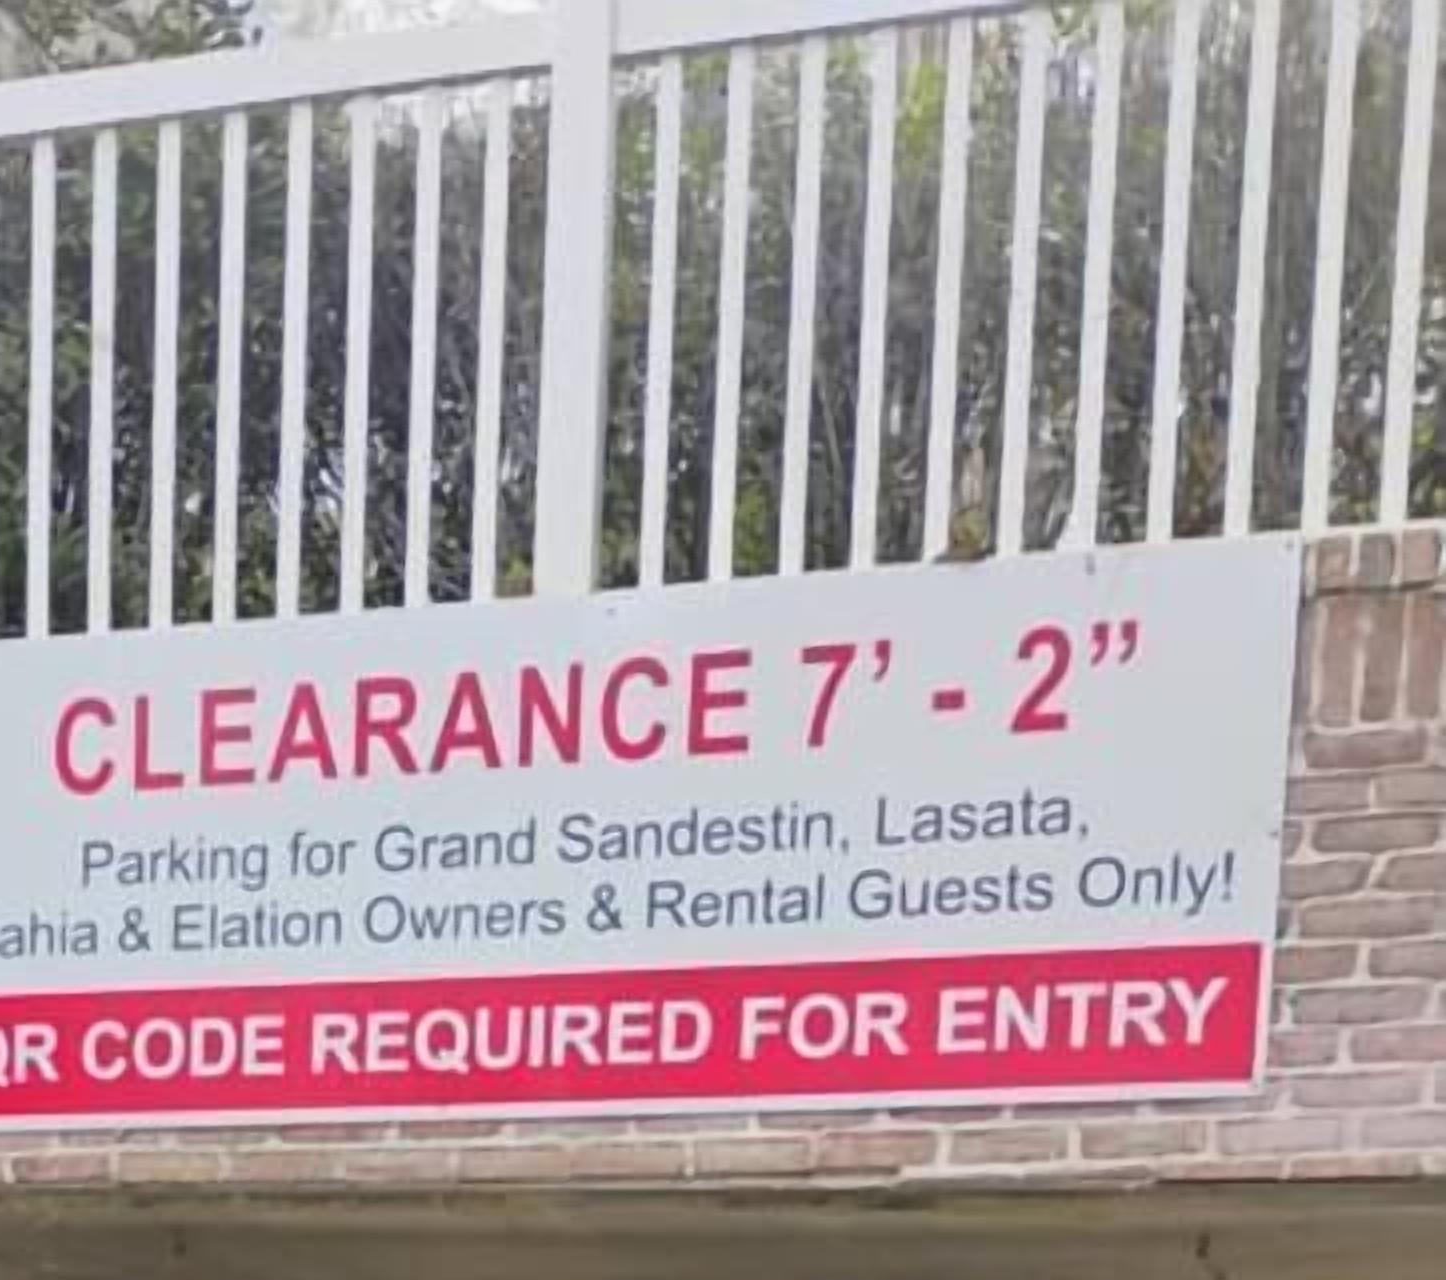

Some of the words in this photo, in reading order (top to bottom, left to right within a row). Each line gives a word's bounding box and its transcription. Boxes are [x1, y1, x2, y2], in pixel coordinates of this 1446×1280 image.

[54, 648, 752, 796] CLEARANCE
[80, 839, 270, 893] Parking
[289, 830, 357, 877] for
[373, 817, 538, 873] Grand
[557, 807, 852, 864] Sandestin,
[875, 790, 1090, 847] Lasata,
[117, 907, 153, 953] &
[172, 903, 343, 952] Elation
[363, 894, 568, 944] Owners
[585, 885, 625, 933] &
[645, 873, 827, 930] Rental
[847, 865, 1056, 921] Guests
[1077, 850, 1237, 917] Only!
[81, 1015, 286, 1080] CODE
[310, 1000, 713, 1075] REQUIRED
[739, 992, 910, 1062] FOR
[936, 977, 1229, 1053] ENTRY
